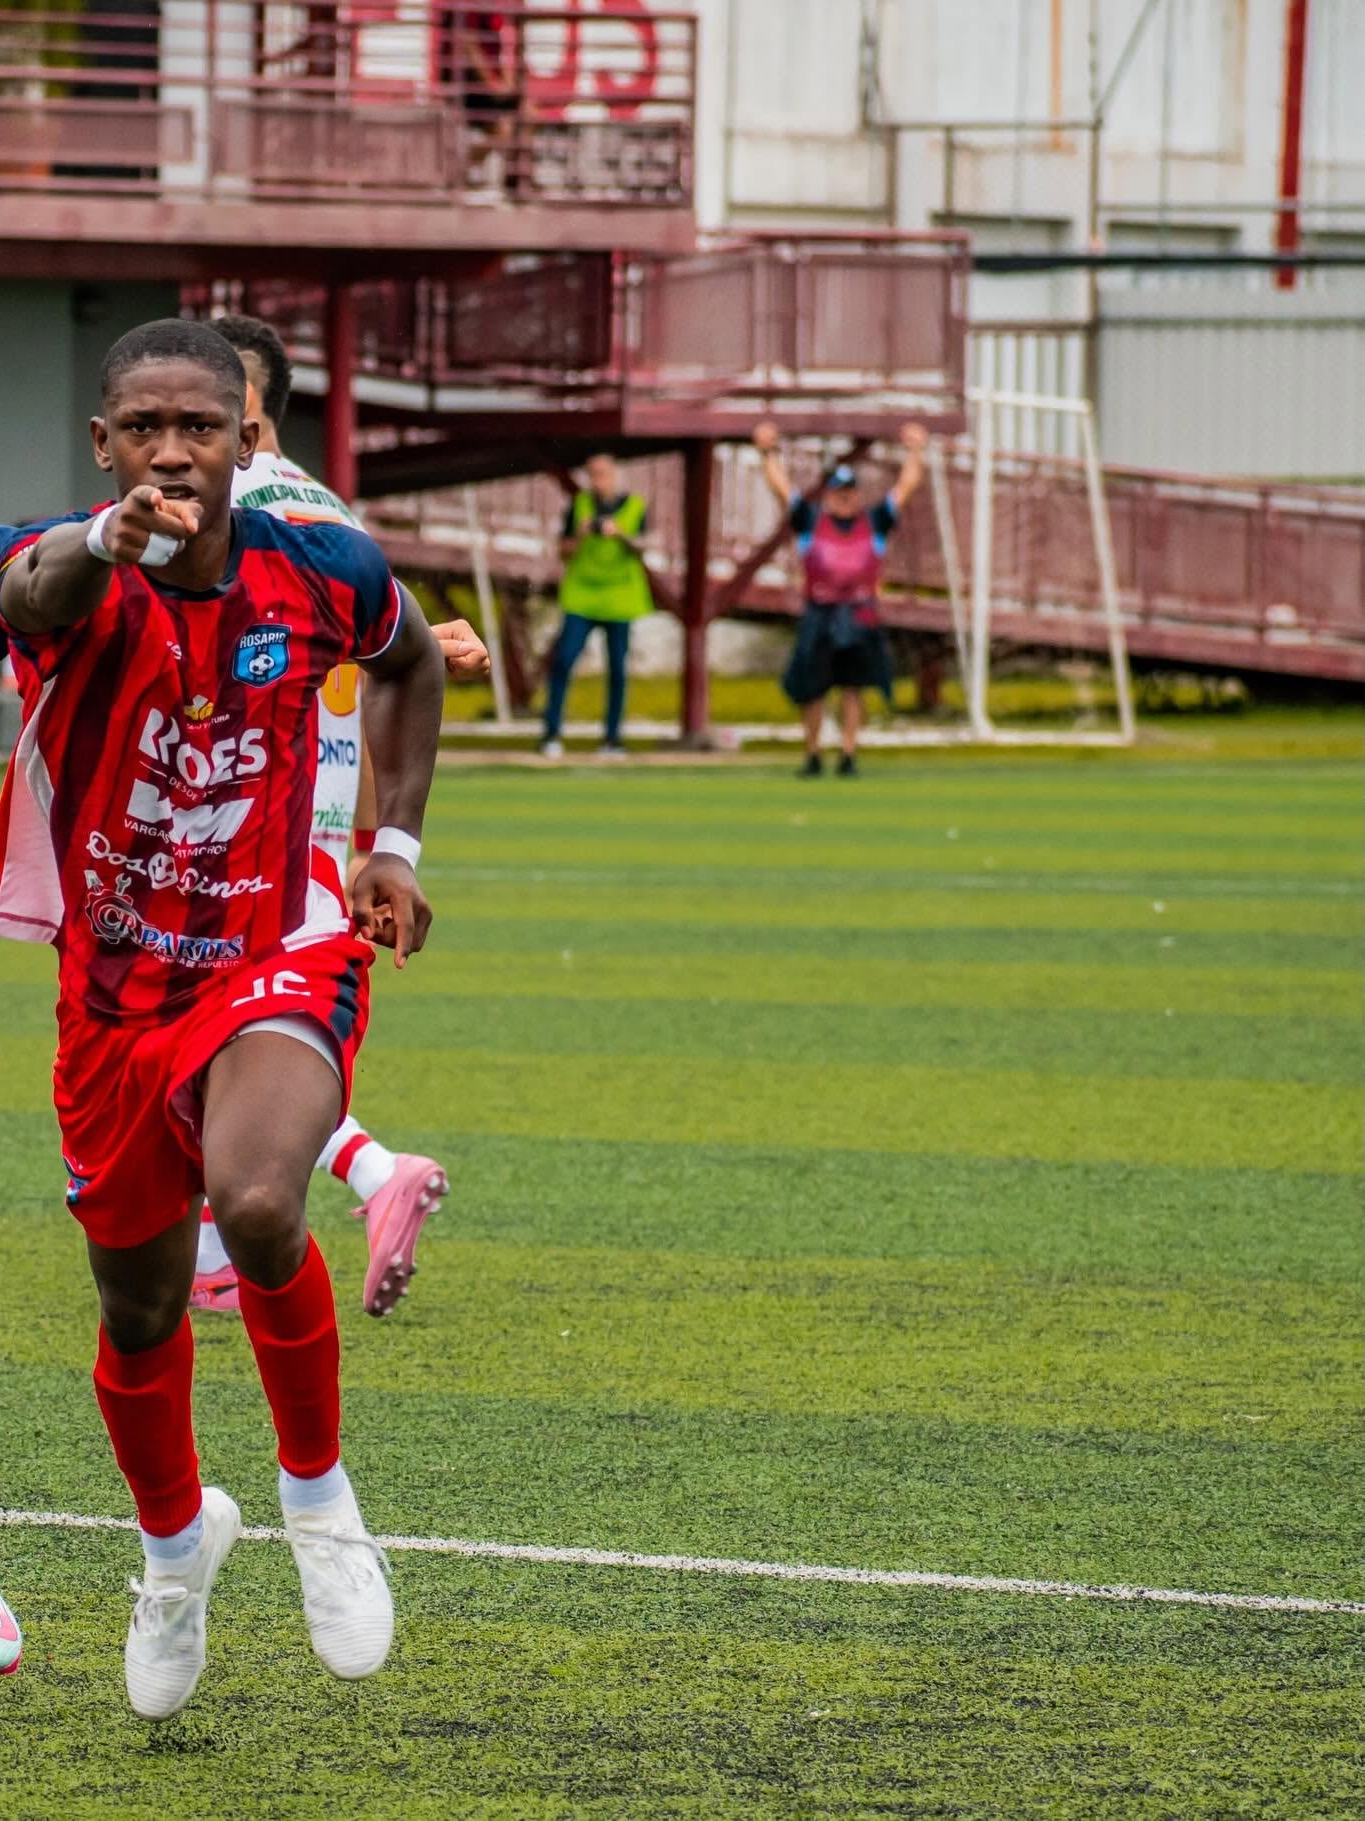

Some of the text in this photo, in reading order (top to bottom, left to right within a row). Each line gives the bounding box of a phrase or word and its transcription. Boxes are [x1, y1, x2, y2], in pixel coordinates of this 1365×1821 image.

[236, 484, 305, 508] MUNICIPAL
[239, 632, 287, 649] ROSARIO
[168, 776, 199, 801] DESDE
[126, 778, 256, 845] VM
[123, 818, 172, 844] VARGAS
[86, 830, 273, 898] Dos Pinos
[140, 925, 244, 960] PARTES
